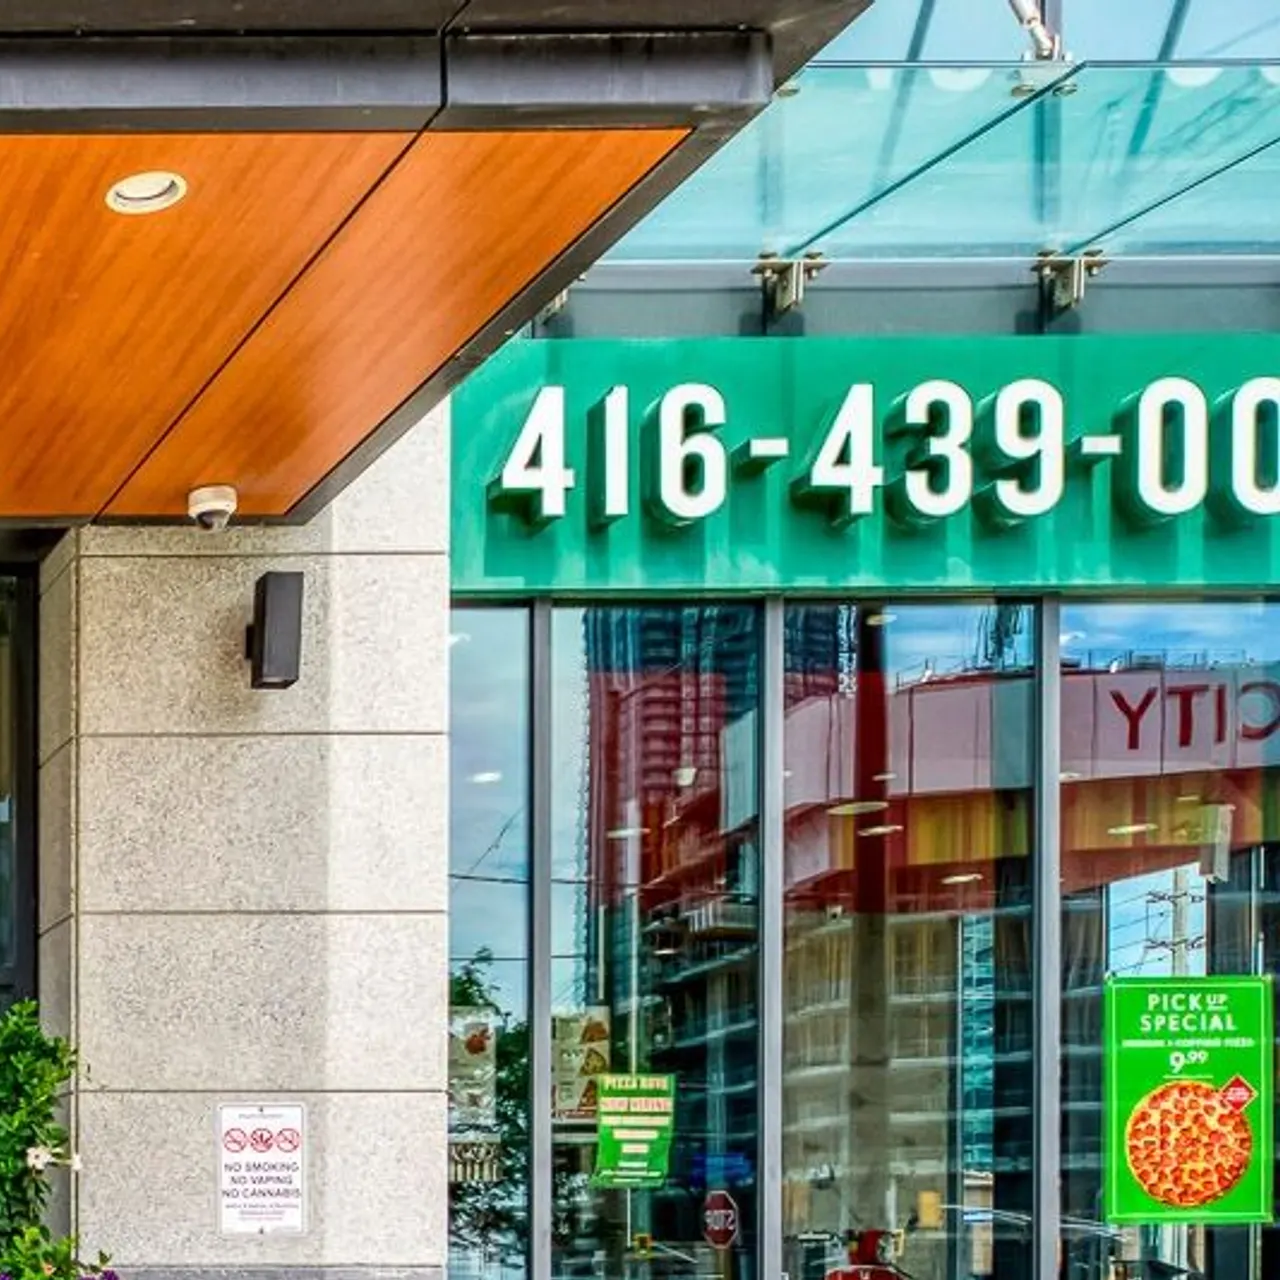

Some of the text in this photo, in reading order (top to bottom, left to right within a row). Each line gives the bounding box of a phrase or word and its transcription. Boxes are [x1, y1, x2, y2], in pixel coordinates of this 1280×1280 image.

[502, 376, 1280, 519] 416-439-00
[1147, 993, 1229, 1012] PICK UP
[1139, 1014, 1238, 1032] SPECIAL
[224, 1162, 299, 1173] NO SMOKING
[230, 1175, 293, 1185] NO VAPING
[222, 1188, 301, 1199] NO CANNABIS
